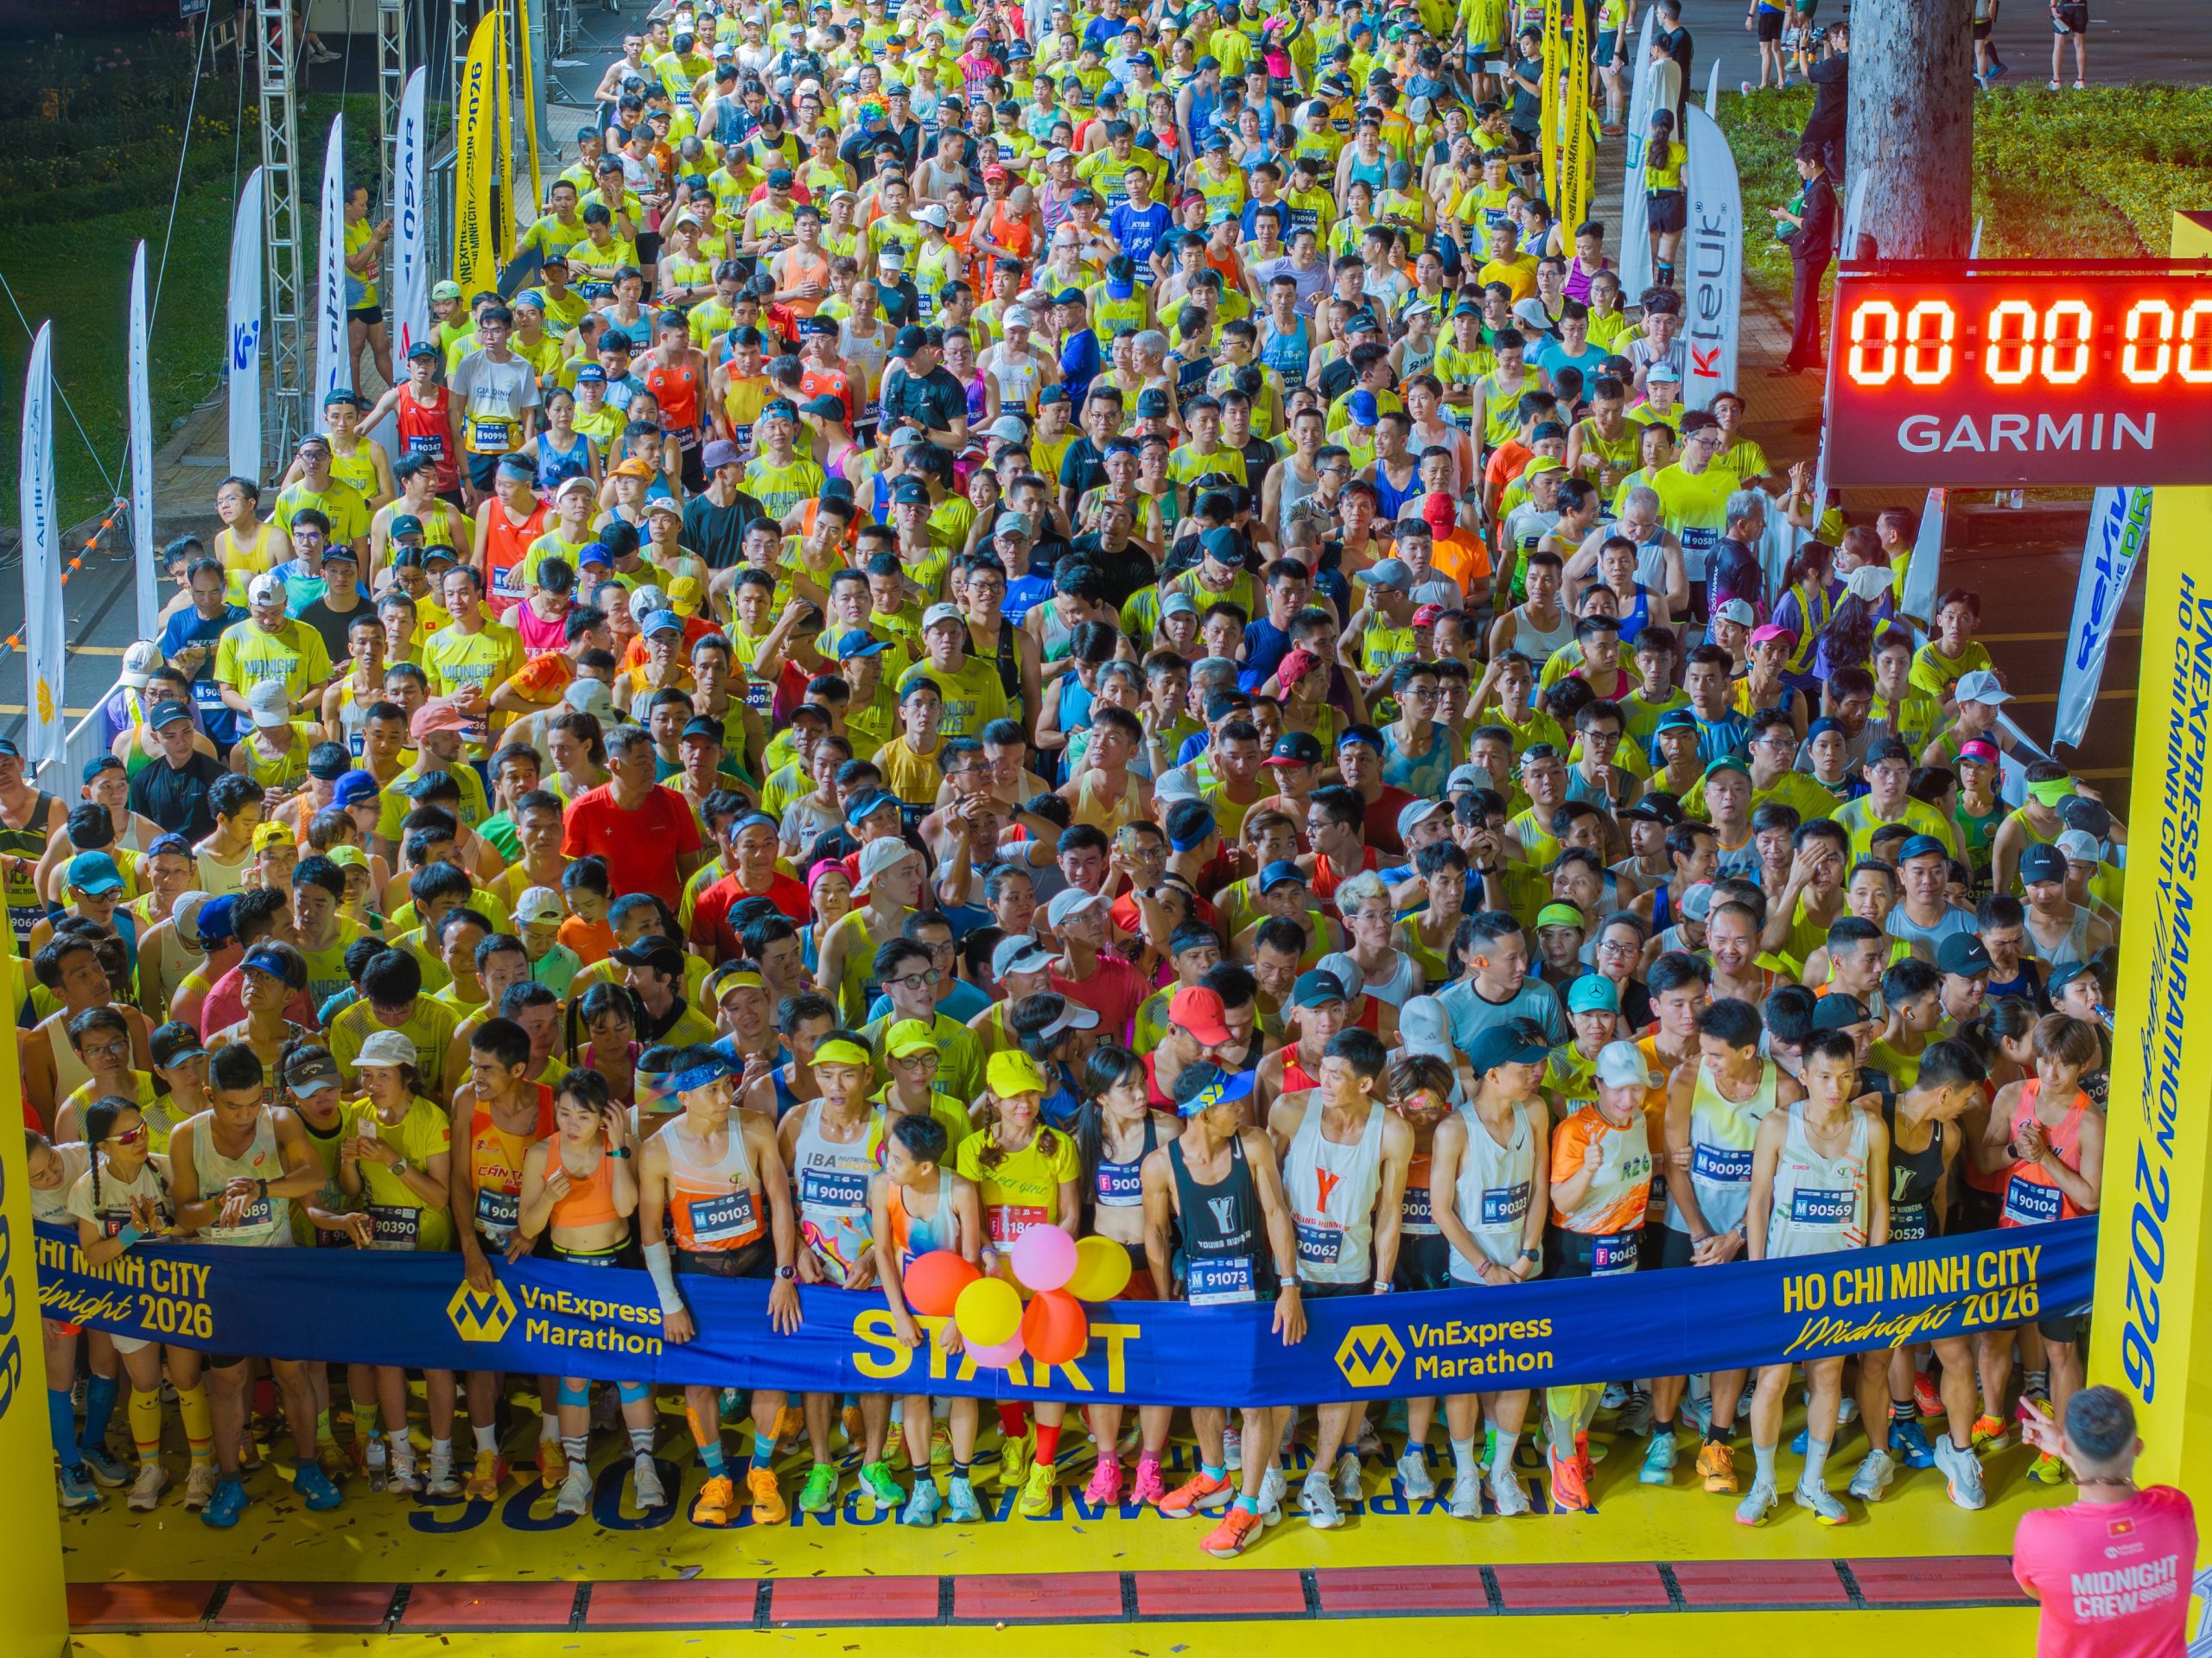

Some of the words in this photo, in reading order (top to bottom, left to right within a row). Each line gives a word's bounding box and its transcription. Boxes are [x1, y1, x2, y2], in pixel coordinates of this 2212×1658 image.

[1897, 412, 2156, 454] GARMIN
[418, 443, 442, 452] 90347
[1692, 537, 1716, 545] 90581
[2177, 571, 2195, 632] HO
[244, 658, 300, 674] MIDNIGHT
[442, 664, 496, 678] MIDNIGHT
[2171, 636, 2190, 706] CHI
[2177, 598, 2212, 881] VNEXPRESS
[2163, 712, 2184, 815] MINH
[2158, 817, 2176, 902] CITY
[2155, 883, 2194, 1160] MARATHON
[806, 1152, 837, 1169] IBA
[838, 1154, 877, 1166] NUTRITION
[1708, 1157, 1751, 1175] 90092
[819, 1185, 863, 1201] 90100
[1112, 1178, 1142, 1191] 900
[1316, 1166, 1347, 1214] Y
[708, 1204, 751, 1226] 90103
[1208, 1196, 1235, 1234] Y
[1402, 1203, 1432, 1217] 9002
[1498, 1197, 1527, 1215] 90323
[1808, 1204, 1852, 1217] 90569
[2018, 1196, 2057, 1214] 90104
[376, 1220, 416, 1235] 90390
[1887, 1227, 1925, 1241] 90529
[1198, 1240, 1224, 1249] YOUNG
[1298, 1239, 1338, 1256] 90062
[1609, 1244, 1637, 1264] 90433
[150, 1258, 212, 1299] CITY
[1206, 1270, 1248, 1286] 91073
[1783, 1274, 1826, 1313] HO
[1834, 1268, 1885, 1308] CHI
[1890, 1255, 1970, 1300] MINH
[1976, 1244, 2042, 1289] CITY
[2123, 1135, 2171, 1405] 2026
[38, 1277, 132, 1326] dnight
[138, 1293, 213, 1338] 2026
[519, 1283, 662, 1326] VnExpress
[1783, 1299, 1959, 1356] Midnight
[1961, 1282, 2040, 1326] 2026
[525, 1318, 663, 1356] Marathon
[1408, 1317, 1553, 1350] VnExpress
[1414, 1350, 1554, 1382] Marathon
[2070, 1553, 2178, 1596] MIDNIGHT
[2074, 1591, 2138, 1618] CREW
